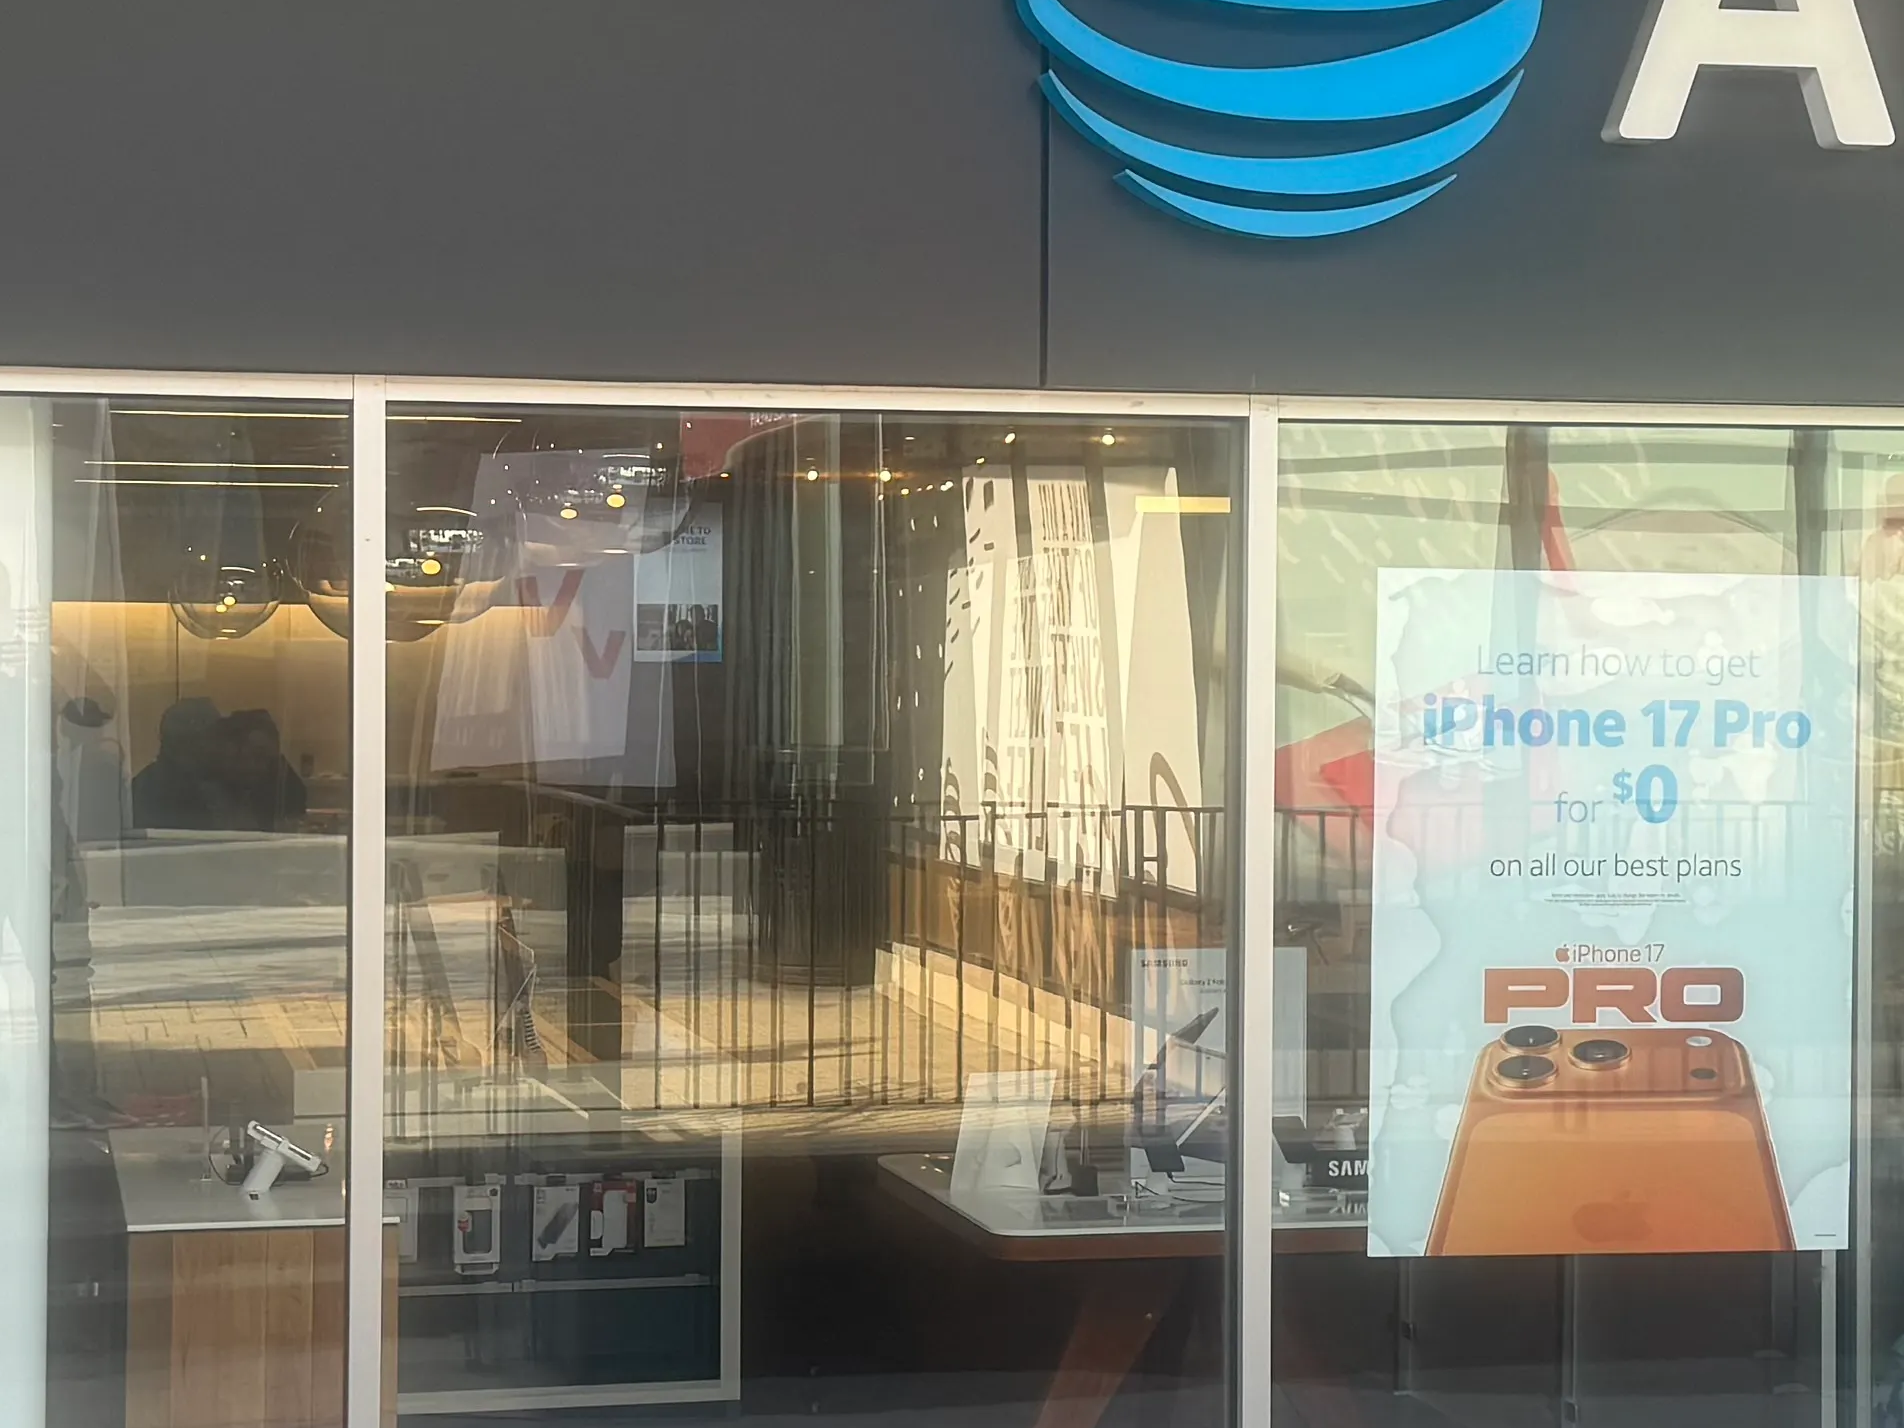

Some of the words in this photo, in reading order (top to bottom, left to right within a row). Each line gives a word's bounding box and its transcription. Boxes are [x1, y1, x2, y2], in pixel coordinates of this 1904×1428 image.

[1477, 646, 1570, 677] Learn
[1581, 645, 1651, 677] how
[1661, 651, 1698, 678] to
[1706, 651, 1760, 686] get
[1422, 692, 1626, 748] iPhone
[1642, 699, 1700, 748] 17
[1714, 699, 1812, 749] Pro
[1554, 792, 1603, 824] for
[1612, 763, 1679, 824] $0
[1490, 857, 1523, 878] on
[1530, 853, 1557, 878] all
[1564, 857, 1607, 878] our
[1614, 853, 1669, 879] best
[1676, 854, 1742, 883] plans
[1572, 944, 1641, 966] iPhone
[1644, 944, 1665, 963] 17
[1484, 967, 1745, 1023] PRO
